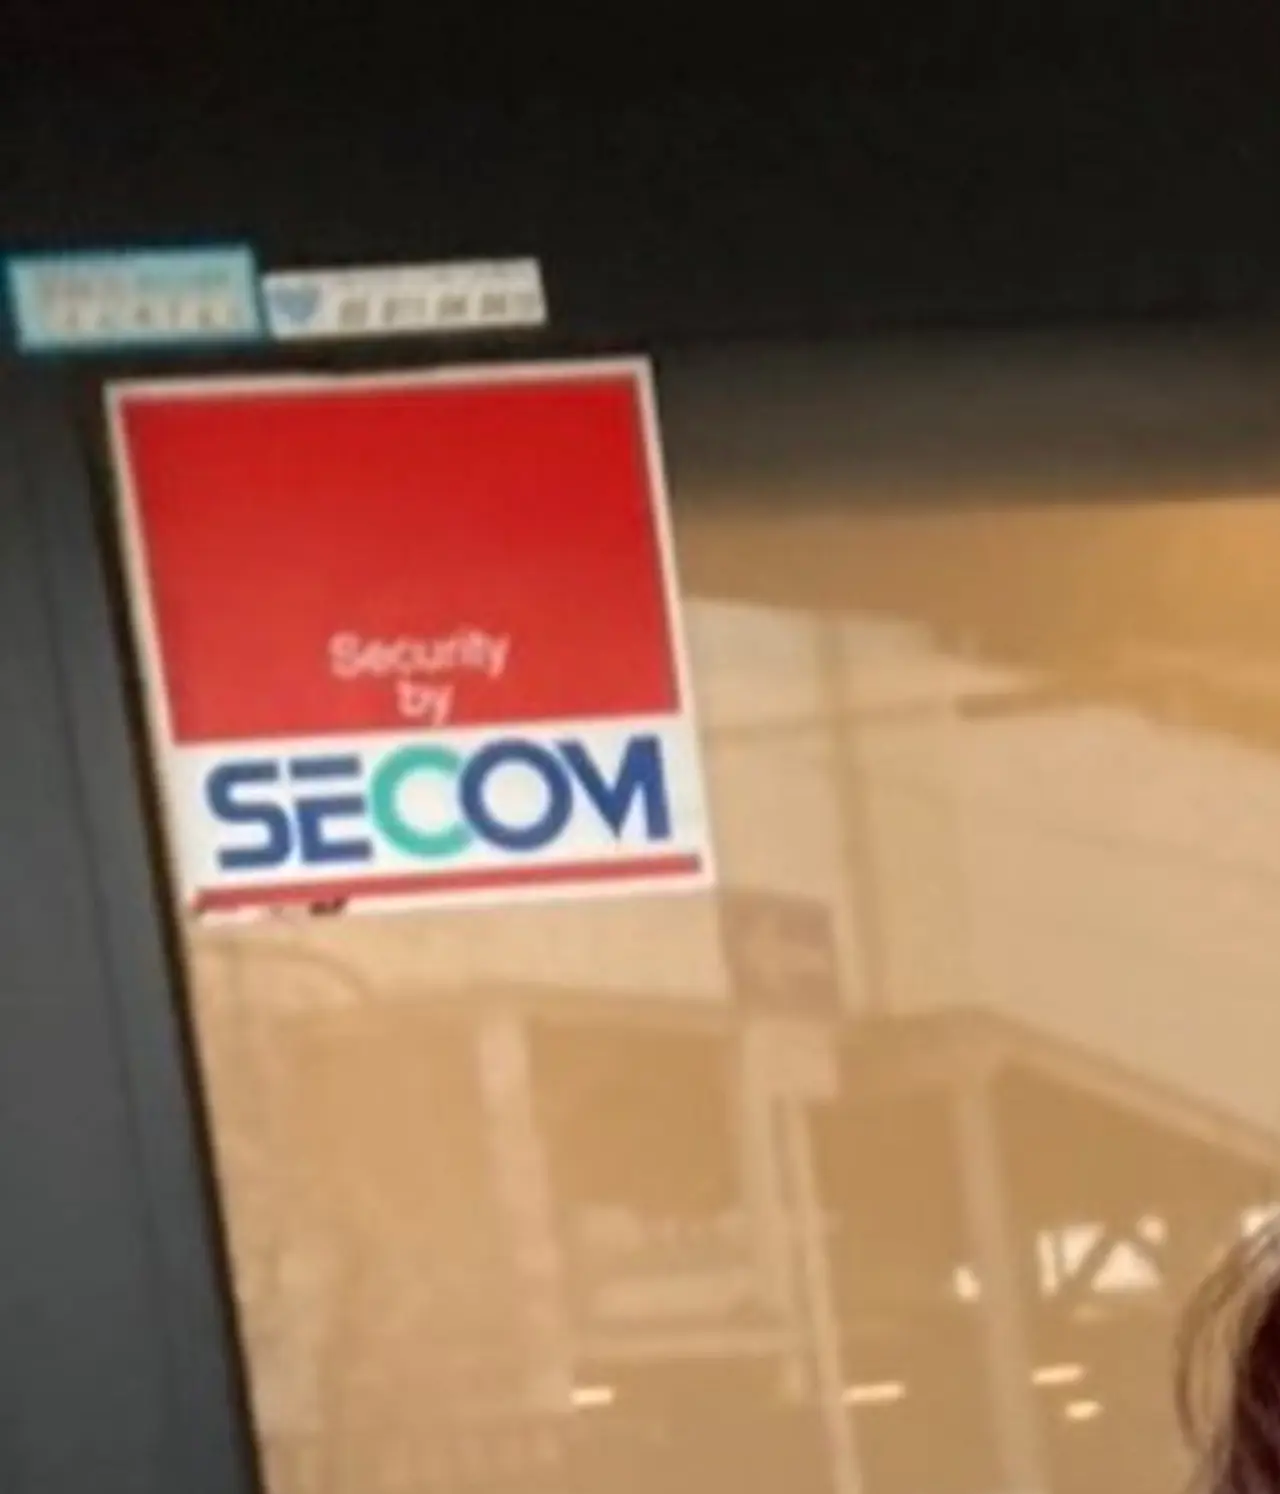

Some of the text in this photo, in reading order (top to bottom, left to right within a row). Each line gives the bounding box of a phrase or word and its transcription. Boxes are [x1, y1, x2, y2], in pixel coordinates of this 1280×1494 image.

[327, 628, 511, 680] Security
[396, 678, 455, 727] by
[204, 733, 672, 871] SECOM
